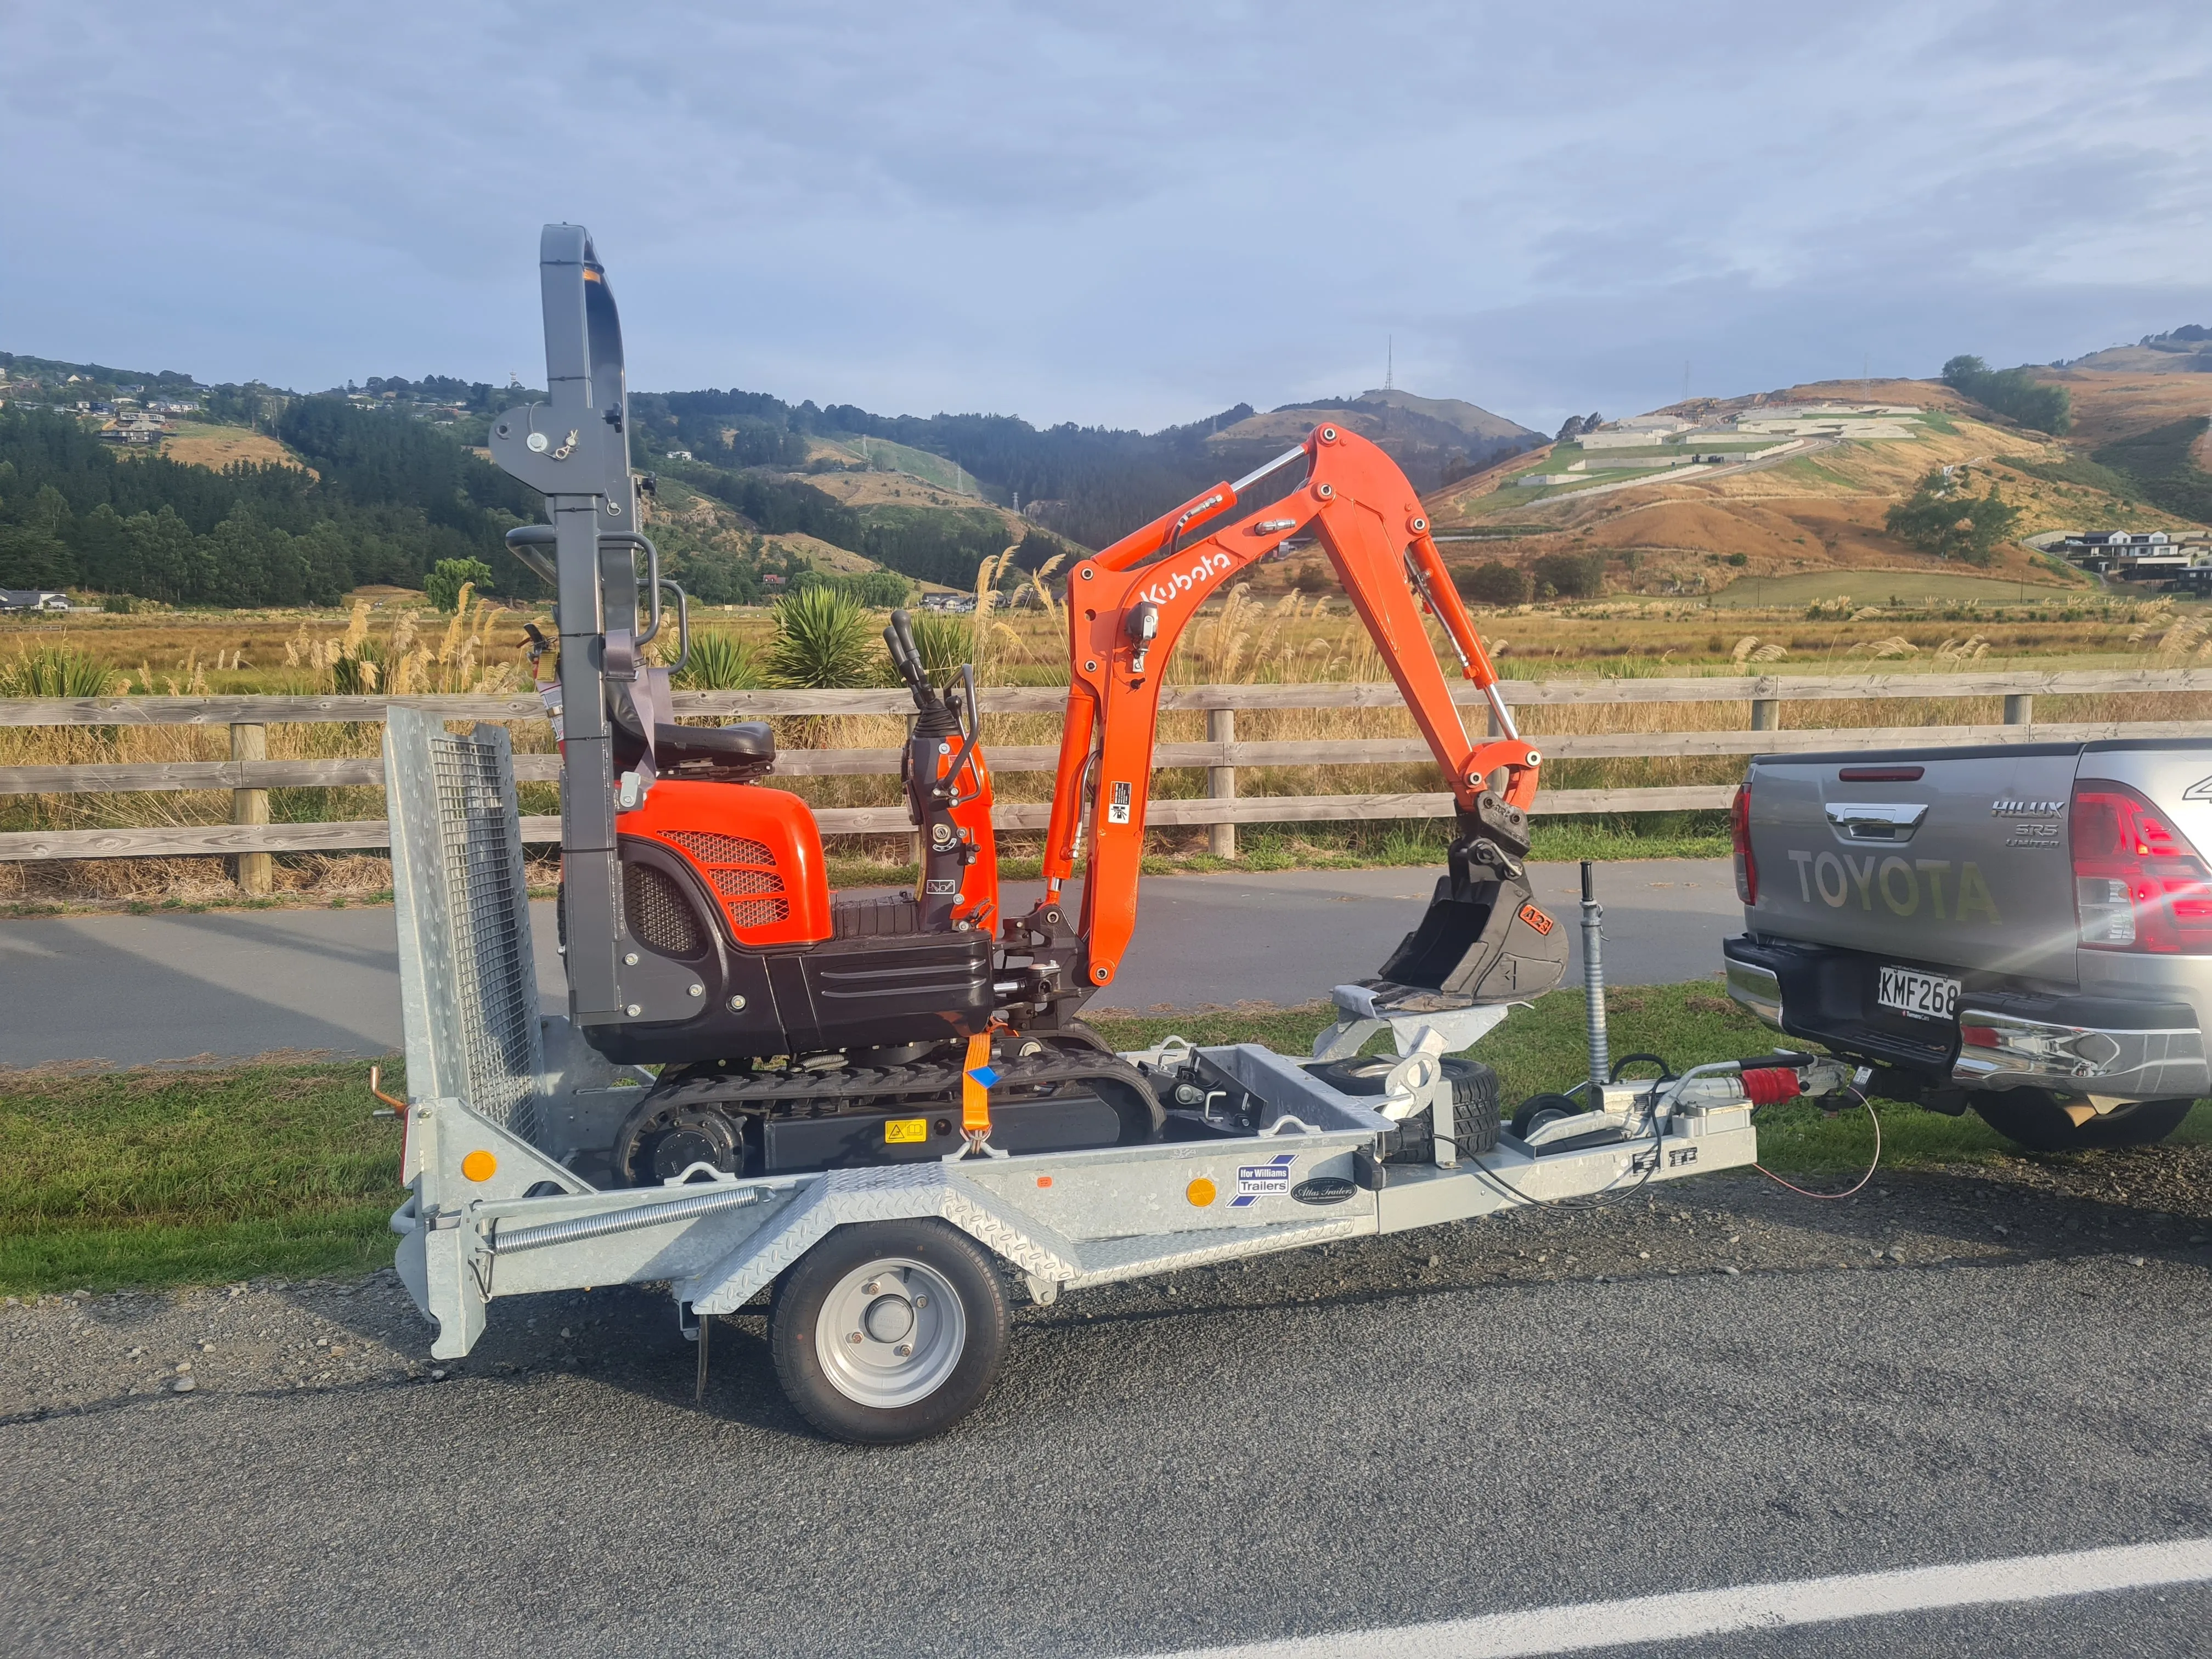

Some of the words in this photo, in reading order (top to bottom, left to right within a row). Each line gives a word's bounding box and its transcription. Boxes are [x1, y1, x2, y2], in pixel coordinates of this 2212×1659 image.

[1139, 552, 1231, 605] Kubota
[1991, 800, 2064, 818] HILUX
[2016, 824, 2058, 836] SR5
[2006, 838, 2059, 848] LIMITED
[1788, 850, 2002, 926] TOYOTA
[1881, 972, 1958, 1015] KMF268
[1240, 1169, 1254, 1178] Ifor
[1254, 1169, 1287, 1177] Williams
[1241, 1181, 1286, 1190] Trailers
[1295, 1186, 1319, 1197] Atlas
[1321, 1185, 1352, 1195] Trailers
